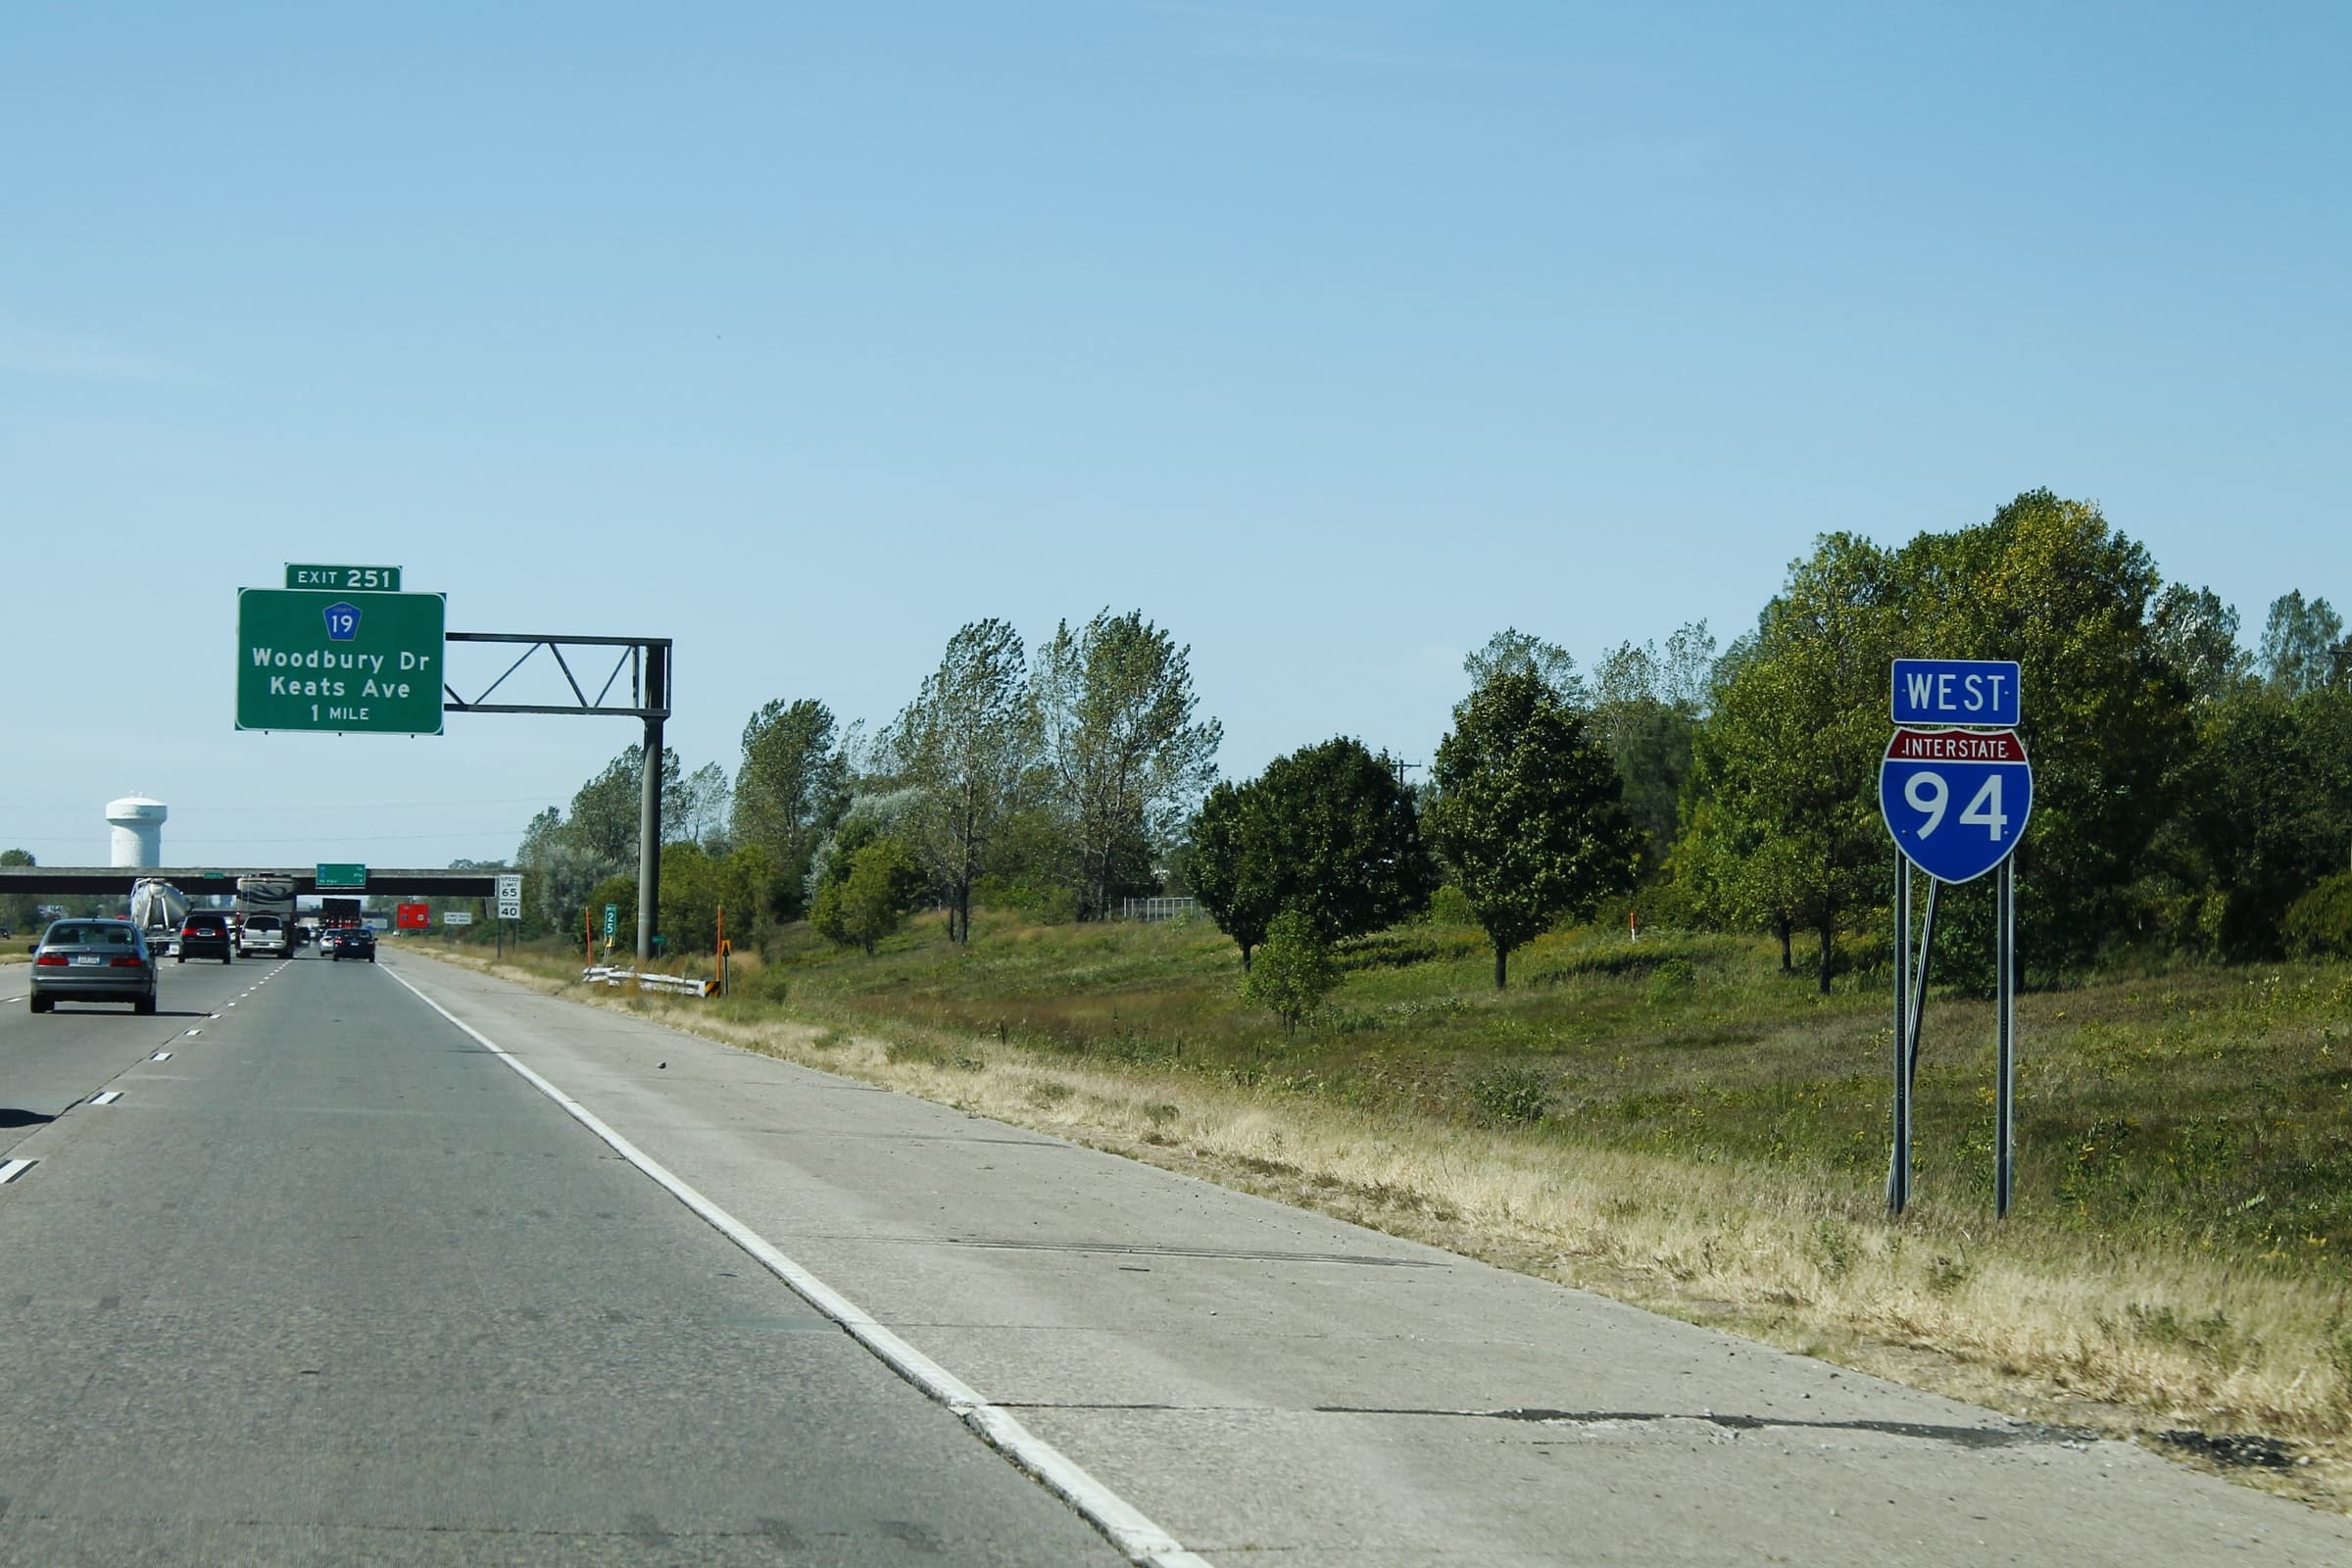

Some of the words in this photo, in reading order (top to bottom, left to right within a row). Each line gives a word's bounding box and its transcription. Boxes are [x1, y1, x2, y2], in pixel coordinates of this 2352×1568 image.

[298, 570, 337, 584] EXIT
[347, 569, 389, 588] 251
[331, 614, 353, 633] 19
[253, 648, 384, 674] Woodbury
[400, 651, 430, 670] Dr
[270, 676, 345, 697] Keats
[362, 678, 410, 699] Ave
[1906, 673, 2005, 711] WEST
[312, 704, 318, 721] 1
[329, 707, 369, 720] MILE
[1905, 738, 2007, 759] INTERSTATE
[1904, 770, 2007, 842] 94
[502, 888, 517, 897] 65
[501, 907, 517, 916] 40
